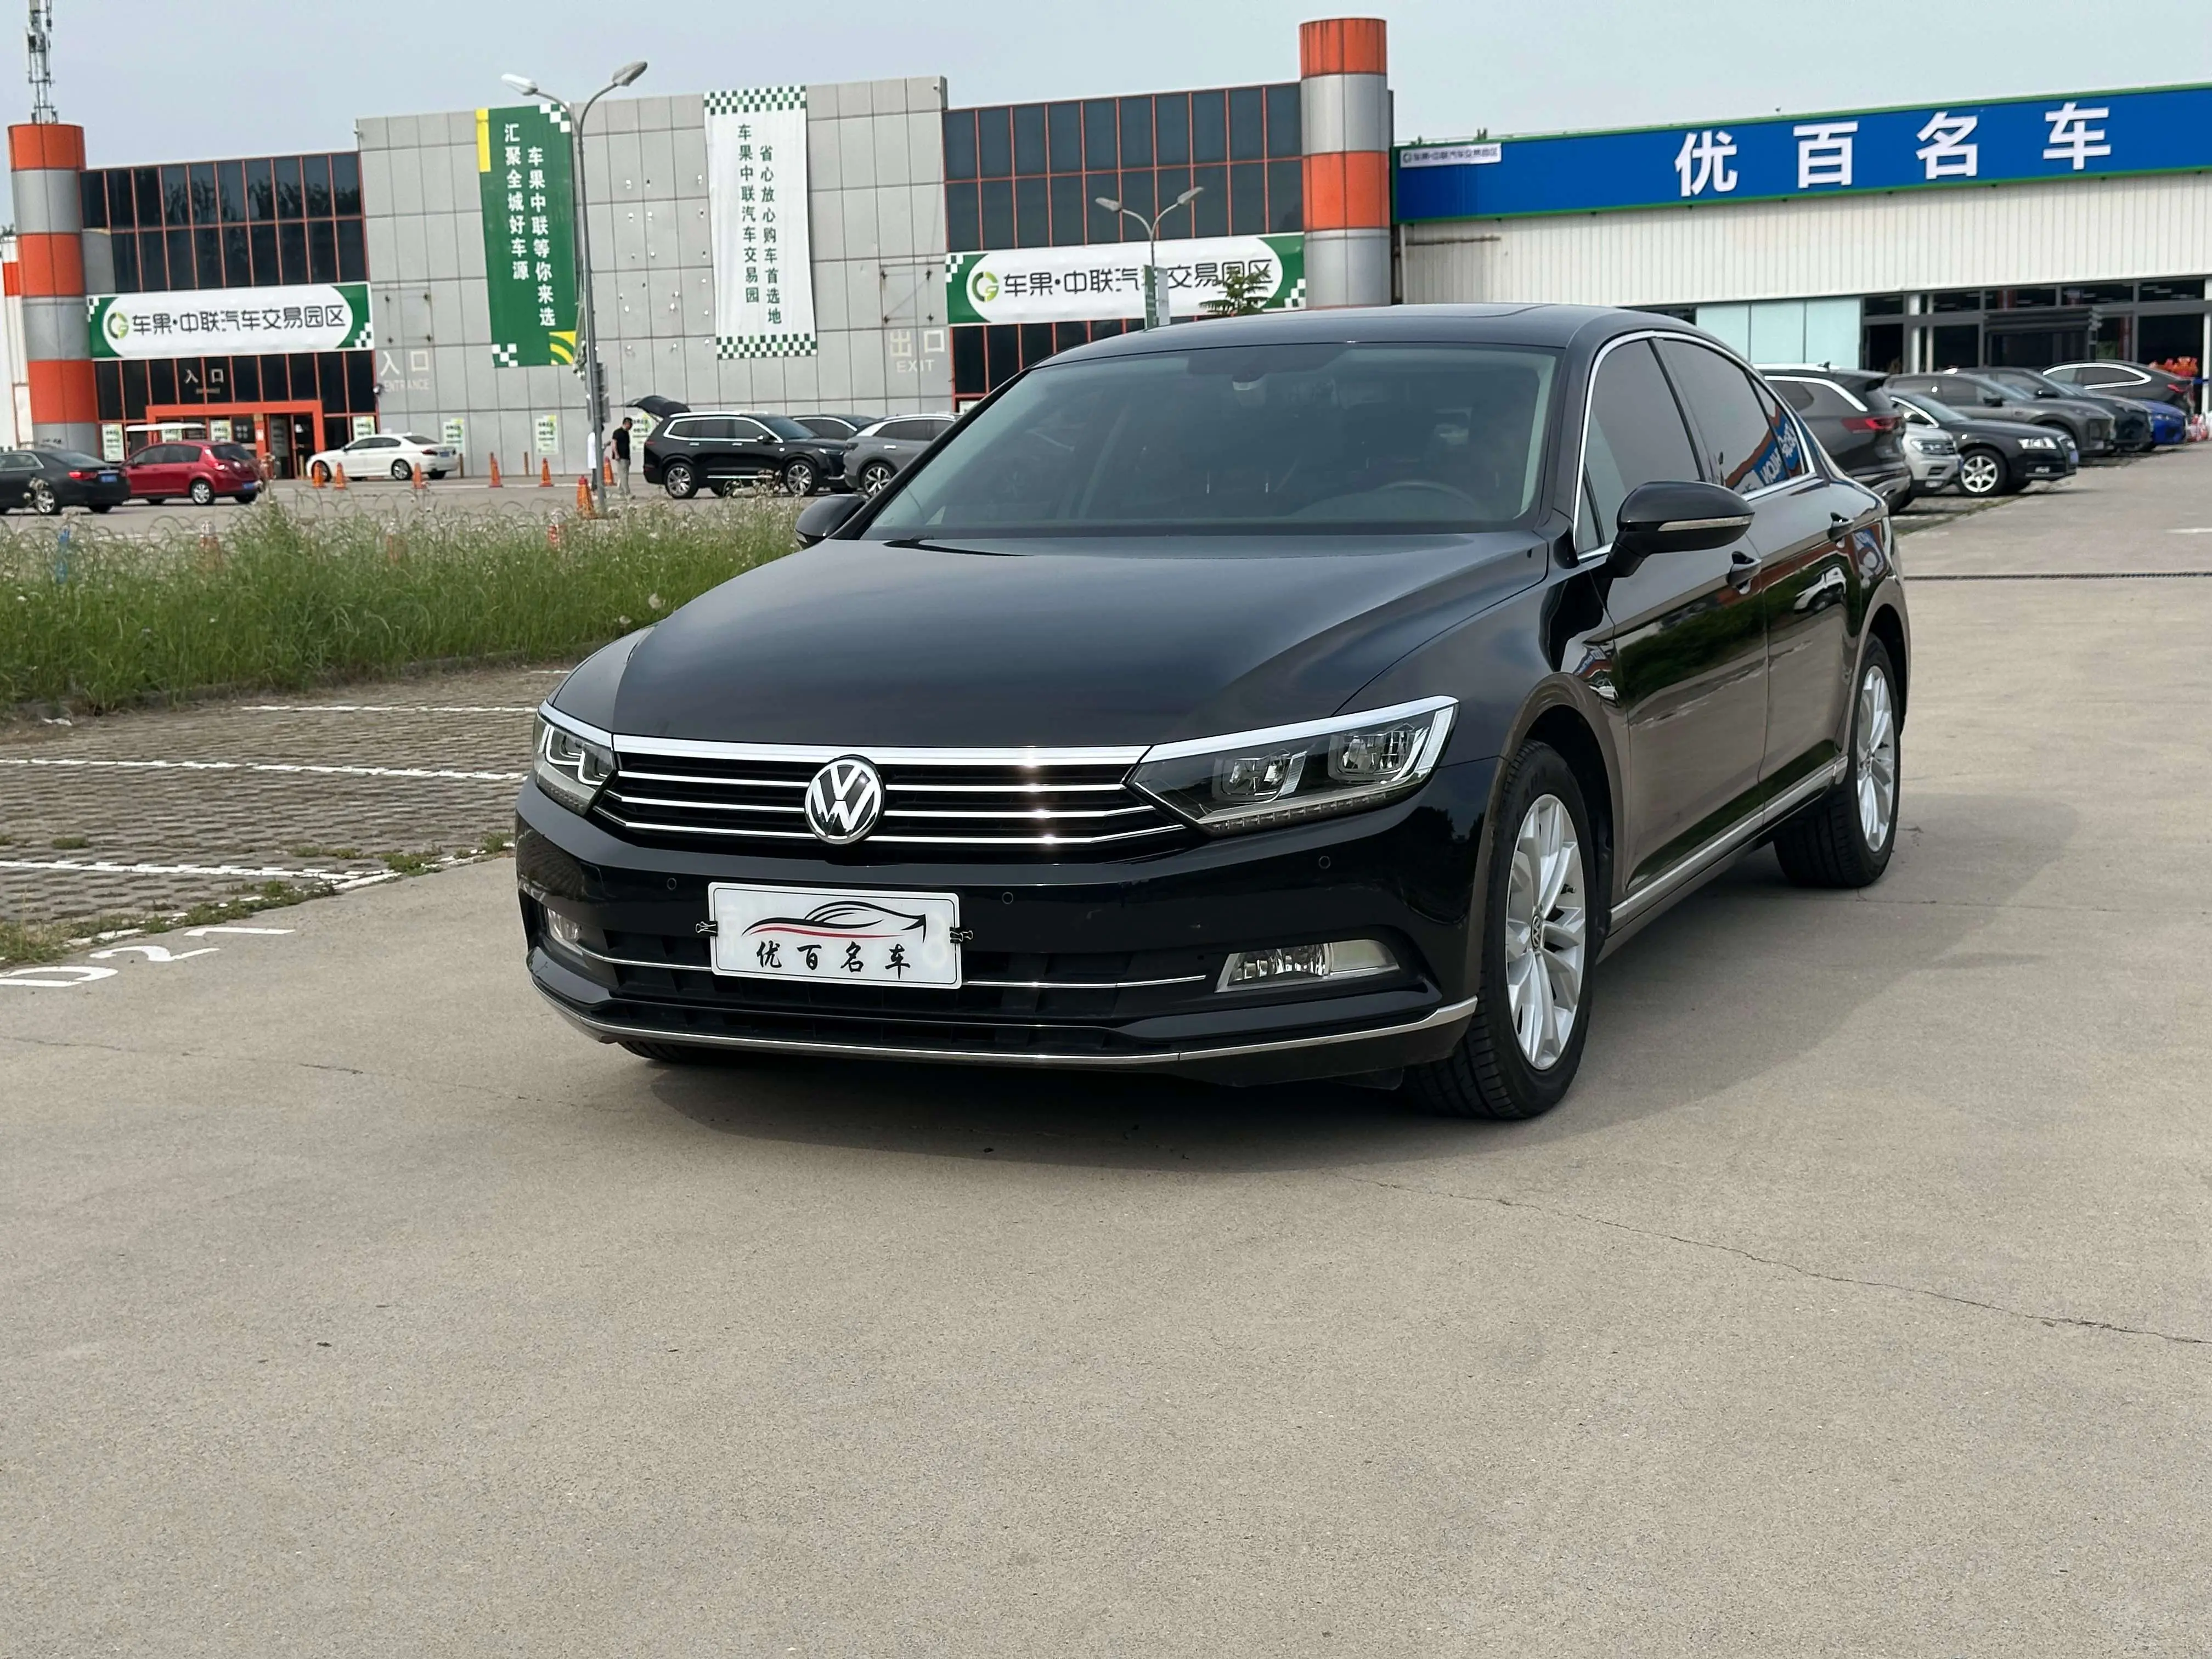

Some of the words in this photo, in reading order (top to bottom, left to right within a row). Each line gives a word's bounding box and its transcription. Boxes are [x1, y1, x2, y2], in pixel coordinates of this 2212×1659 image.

[1673, 102, 2112, 198] 优百名车
[504, 122, 530, 281] 汇聚全城好车源
[737, 123, 760, 303] 车果中联汽车交易园
[527, 146, 556, 327] 车果中联等你来选
[759, 144, 782, 325] 省心放心购车首选地
[132, 304, 346, 335] 车果·中联汽车交易园区
[890, 329, 945, 357] 出口
[184, 368, 224, 384] 入口
[380, 351, 428, 377] 入口
[896, 359, 935, 373] EXIT
[756, 940, 911, 980] 优百名车
